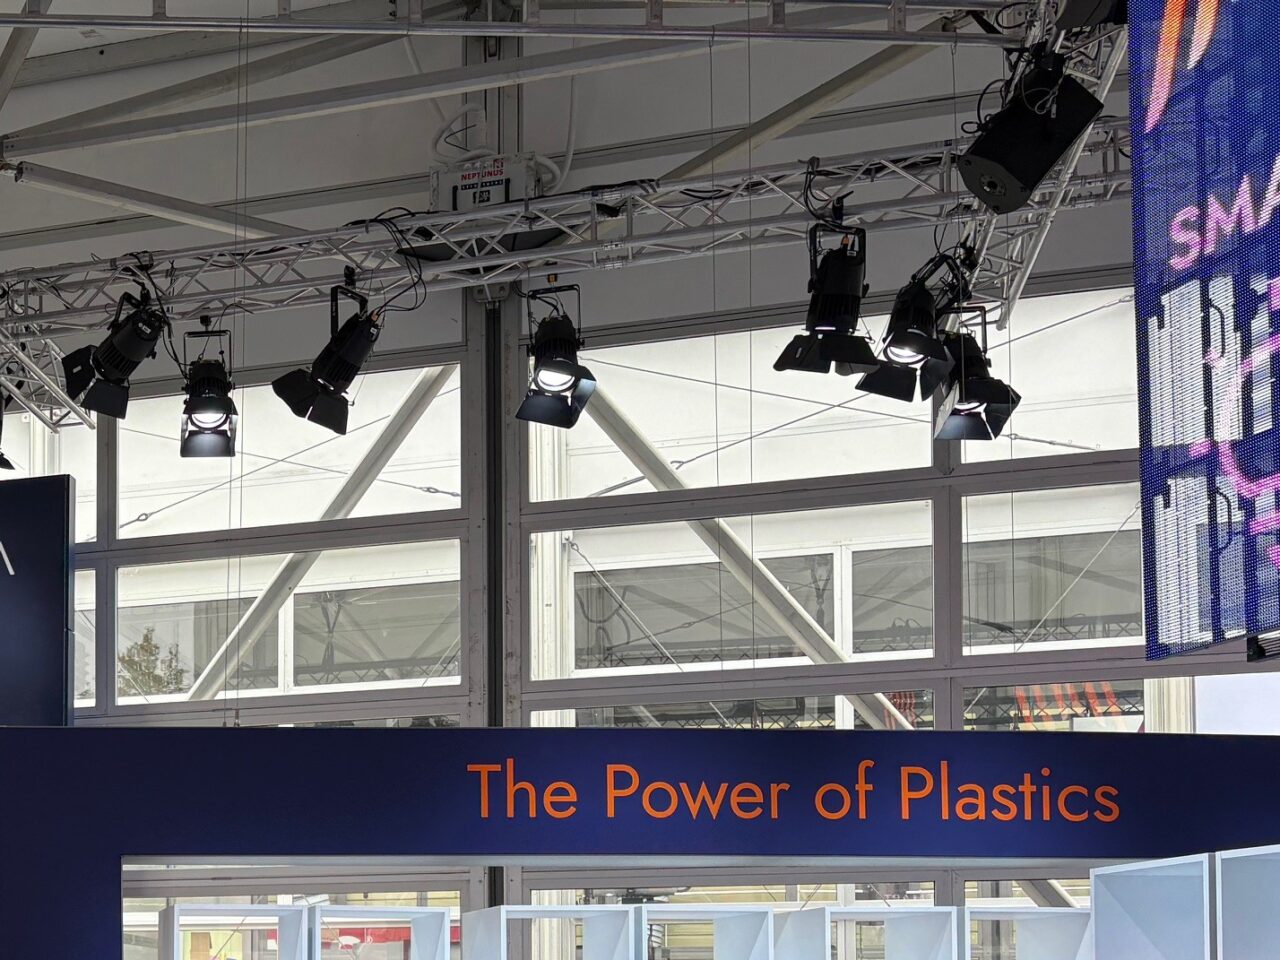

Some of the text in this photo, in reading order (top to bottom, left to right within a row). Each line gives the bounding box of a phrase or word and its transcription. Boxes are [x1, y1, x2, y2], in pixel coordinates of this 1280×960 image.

[460, 169, 504, 181] NEPTUNUS
[467, 758, 1120, 822] The Power of Plastics
